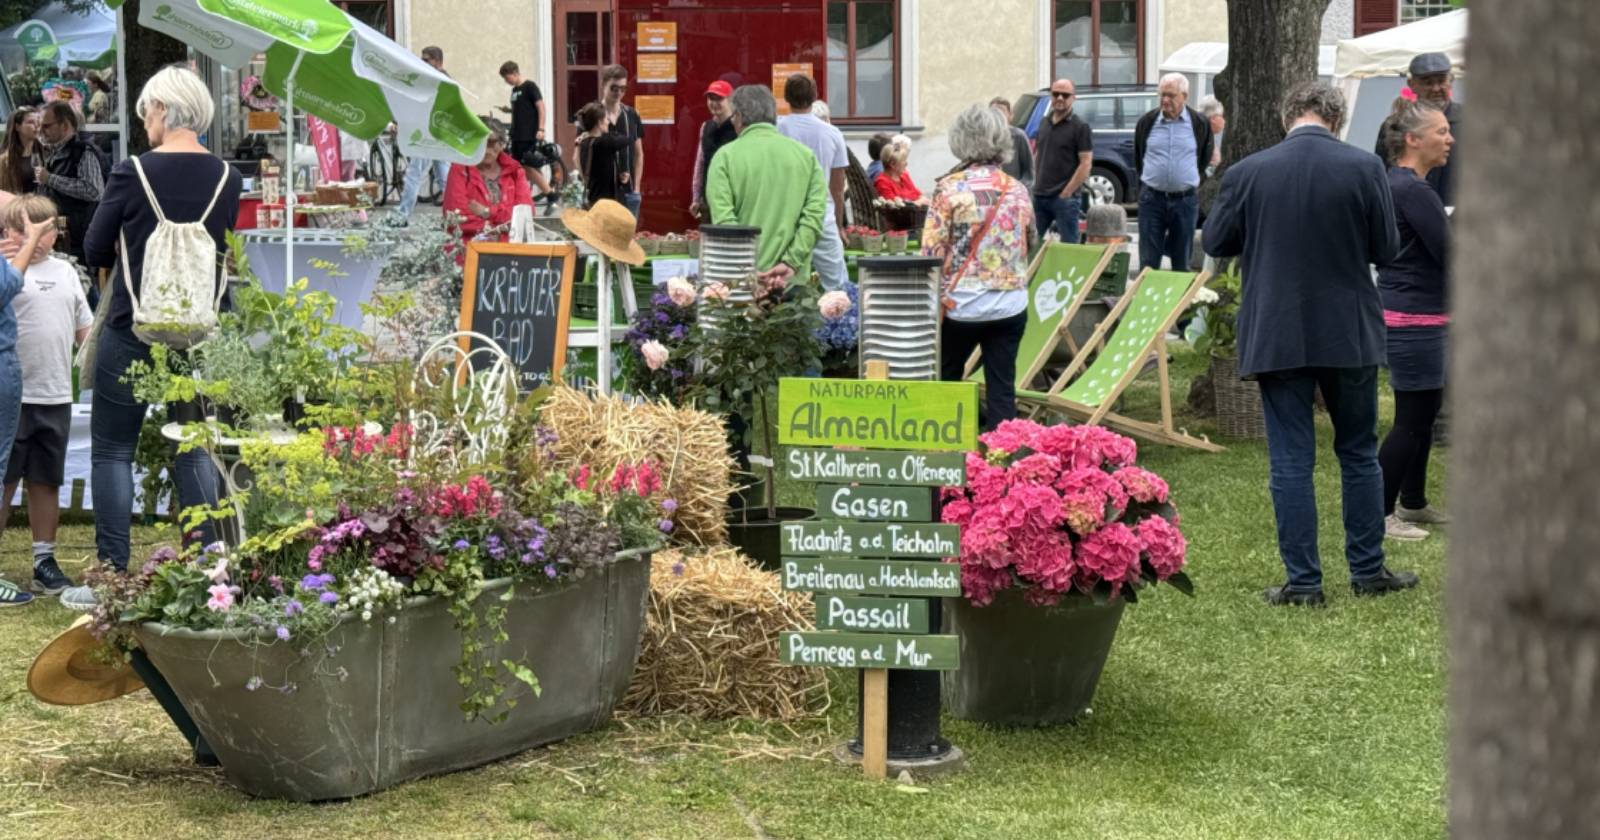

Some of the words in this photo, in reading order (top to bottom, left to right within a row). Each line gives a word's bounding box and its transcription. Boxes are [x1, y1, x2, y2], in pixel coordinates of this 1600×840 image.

[478, 260, 561, 316] KRÄUTER-
[809, 382, 909, 400] NATURPARK
[790, 402, 963, 444] Almenland
[814, 451, 882, 479] Kathrein
[902, 455, 963, 487] Offenegg
[831, 487, 909, 518] Gasen
[784, 525, 853, 553] Fladnitz
[887, 525, 955, 554] Teichalm
[785, 562, 866, 590] Breitenau
[880, 565, 959, 589] Hochlantsch
[828, 597, 911, 629] Passail
[789, 633, 856, 668] Pernegg
[895, 639, 933, 666] Mur
